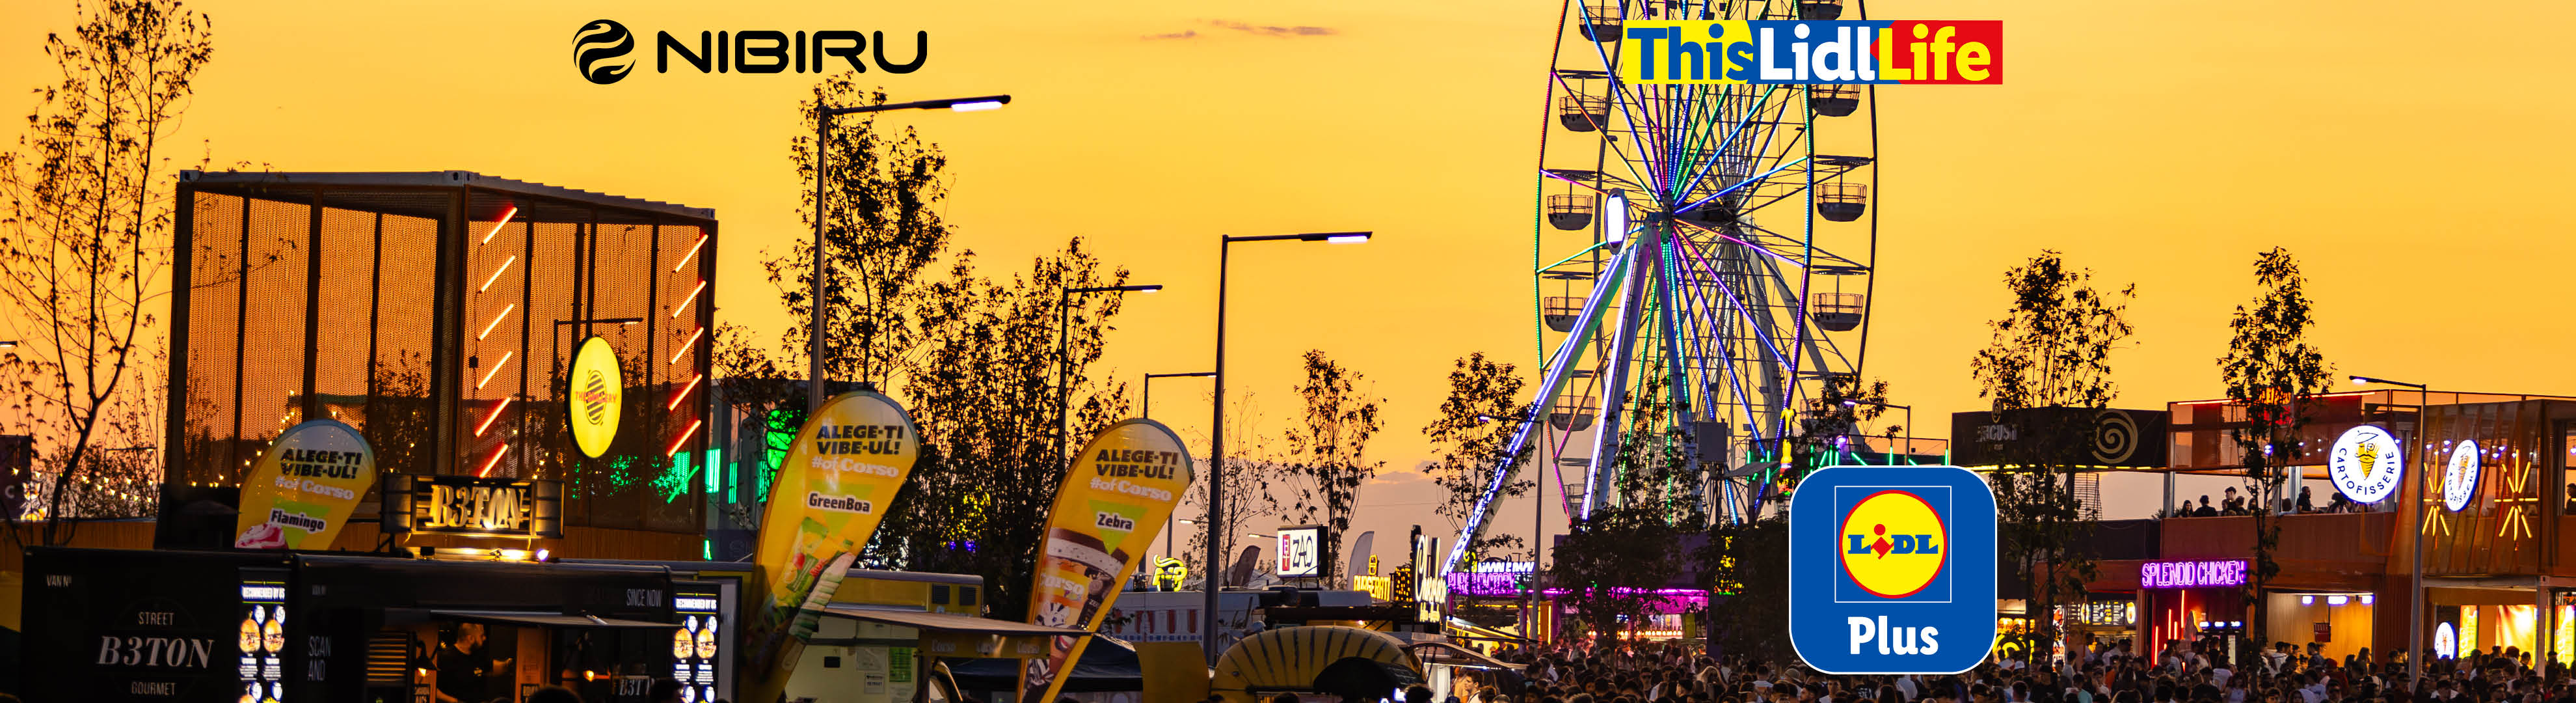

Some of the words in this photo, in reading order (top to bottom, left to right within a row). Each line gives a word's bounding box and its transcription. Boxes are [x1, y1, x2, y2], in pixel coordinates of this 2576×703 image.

[817, 441, 900, 454] VIBE-UL!
[280, 463, 358, 479] VIBE-UL!
[1096, 463, 1175, 479] VIBE-UL!
[2337, 448, 2395, 495] CARTOFISSERIE
[425, 485, 526, 530] B3TON
[809, 493, 870, 512] GreenBoa
[271, 510, 325, 532] Flamingo
[1097, 514, 1133, 530] Zebra
[1293, 535, 1313, 568] ZAO
[47, 575, 62, 587] VAN
[2142, 562, 2195, 586] SPLENDID
[2197, 560, 2245, 585] CHICKEN
[626, 588, 645, 607] SINCE
[646, 590, 662, 607] NOW
[137, 611, 174, 626] STREET
[96, 635, 215, 669] B3TON
[308, 635, 332, 657] SCAN
[307, 659, 327, 682] AND
[131, 682, 178, 695] GOURMET
